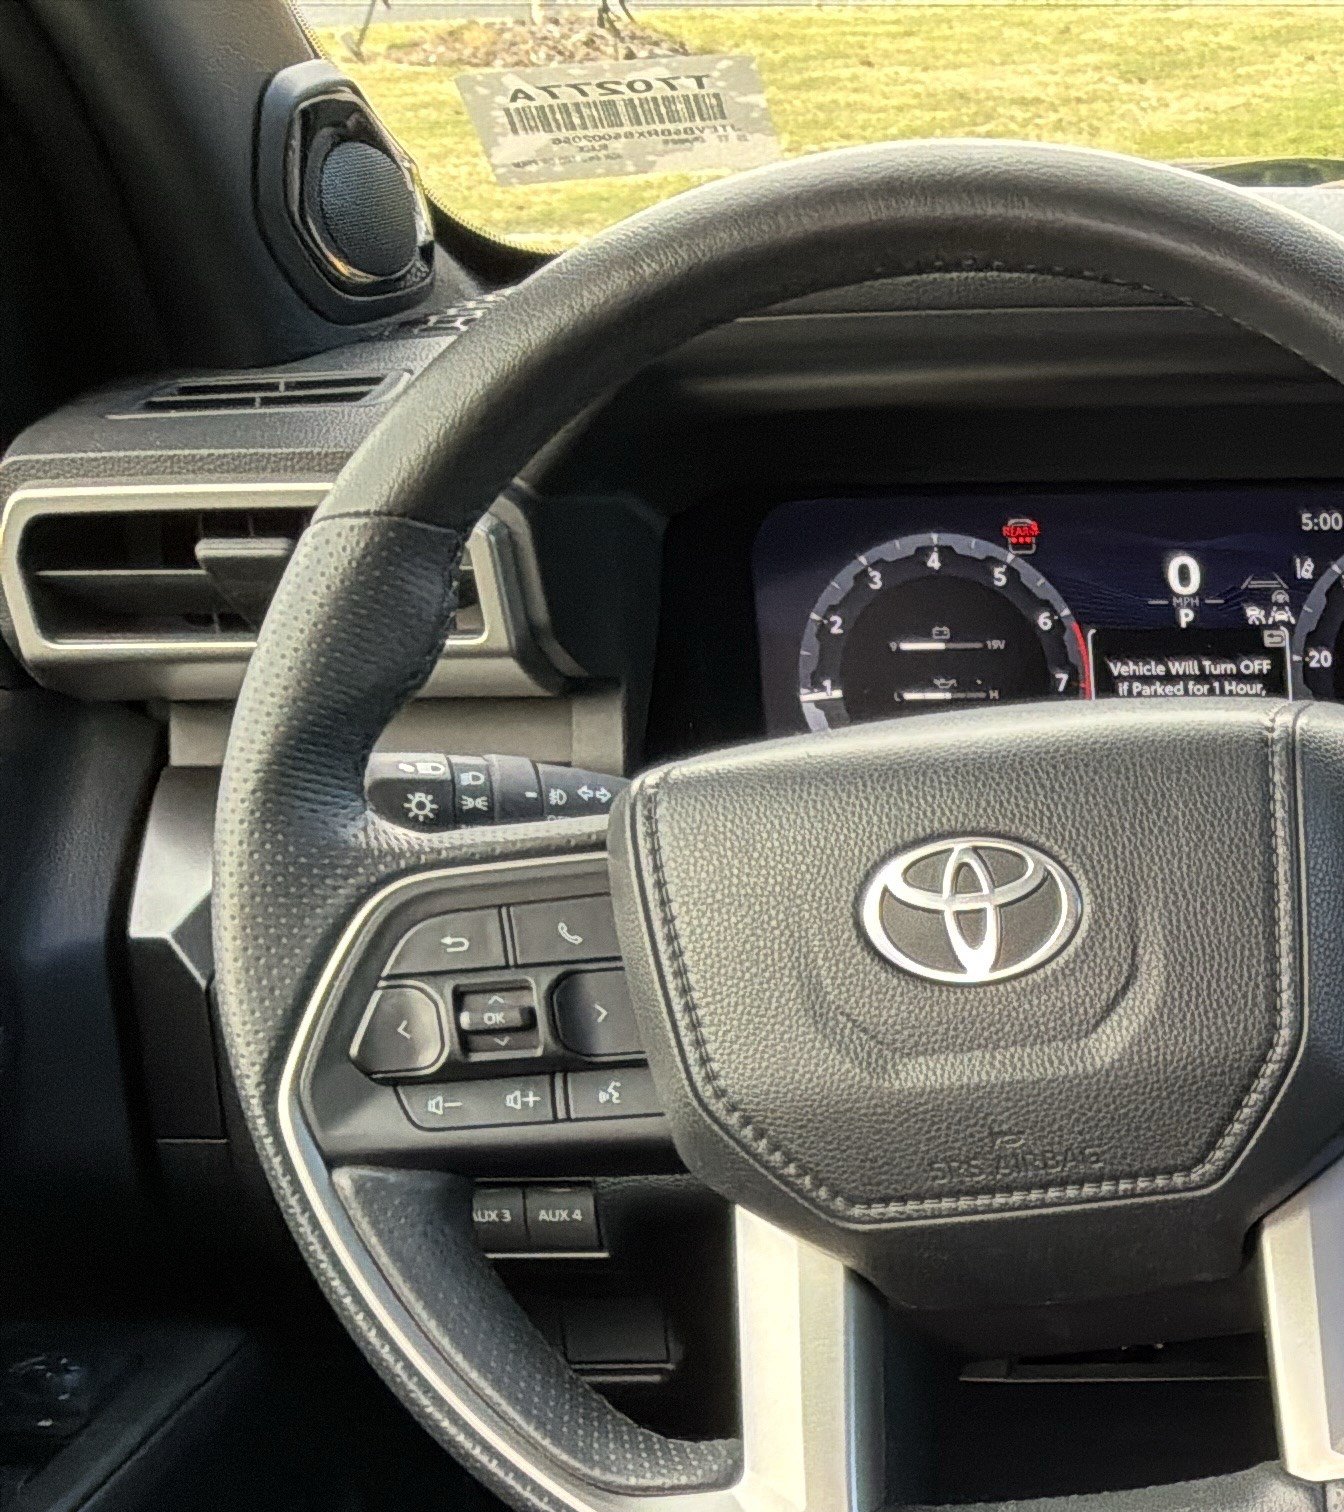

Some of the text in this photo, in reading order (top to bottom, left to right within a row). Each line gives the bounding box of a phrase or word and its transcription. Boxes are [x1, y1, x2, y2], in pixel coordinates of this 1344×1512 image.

[1301, 512, 1344, 531] 5:00
[926, 551, 942, 570] 4
[868, 570, 883, 590] 3
[994, 565, 1008, 587] 5
[1168, 555, 1202, 596] 0
[1172, 596, 1200, 608] MPH
[828, 614, 844, 634] 2
[1037, 611, 1052, 631] 6
[1179, 608, 1195, 629] P
[1109, 659, 1272, 677] Vehicle Will Turn OFF
[1308, 650, 1333, 668] 20
[1055, 672, 1069, 693] 7
[1118, 680, 1267, 697] if Parked for 1 Hour,
[483, 1010, 506, 1026] OK
[472, 1209, 512, 1222] UX 3
[538, 1208, 583, 1222] AUX 4
